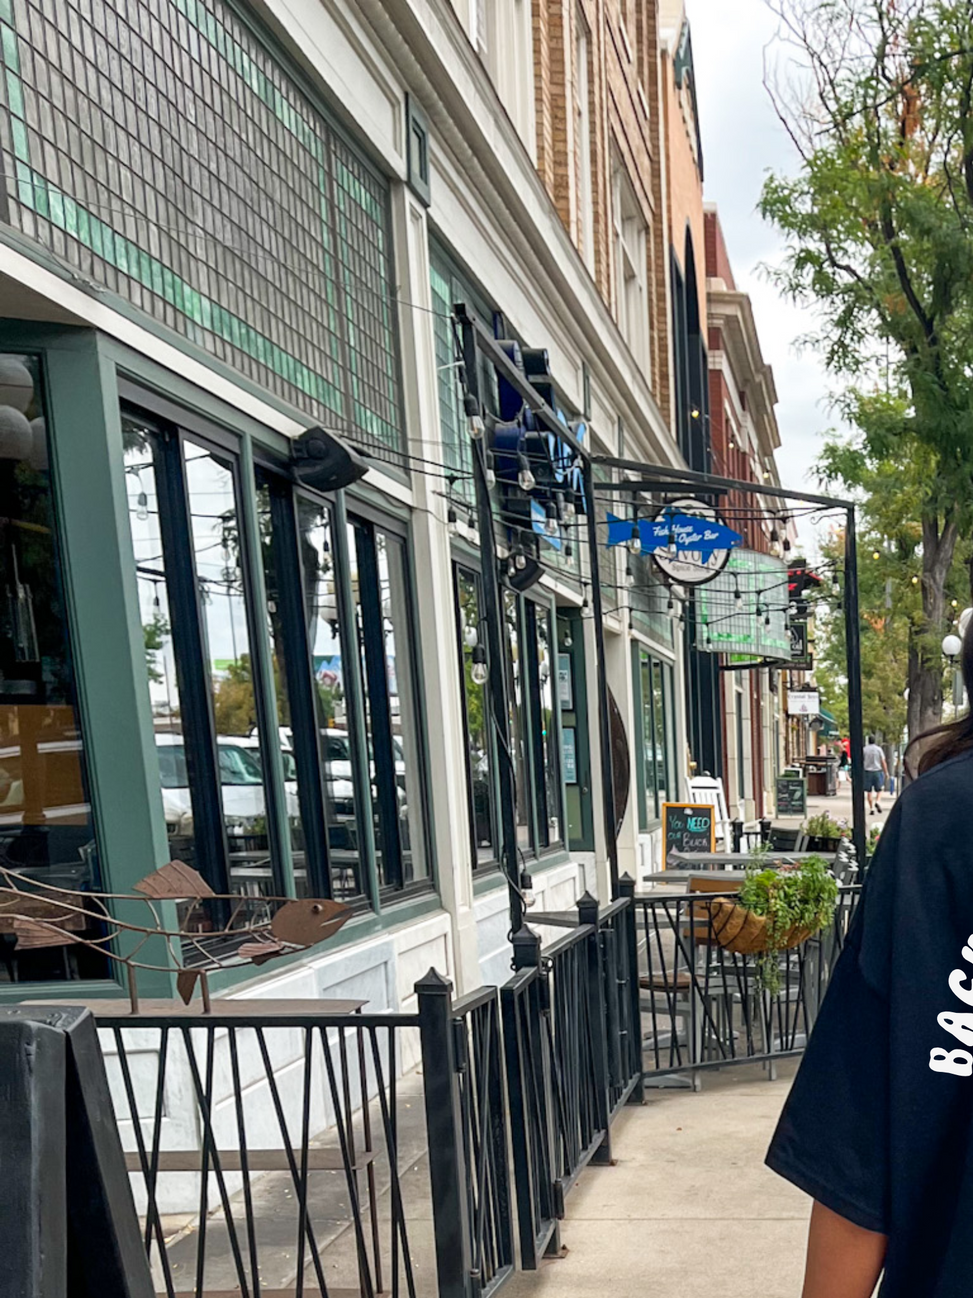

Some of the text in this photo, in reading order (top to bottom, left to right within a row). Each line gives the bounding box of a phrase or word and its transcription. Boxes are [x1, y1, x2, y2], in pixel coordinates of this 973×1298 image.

[653, 525, 670, 536] Fish
[678, 533, 702, 546] Oyster
[703, 530, 720, 540] Bar
[687, 816, 711, 831] NEED
